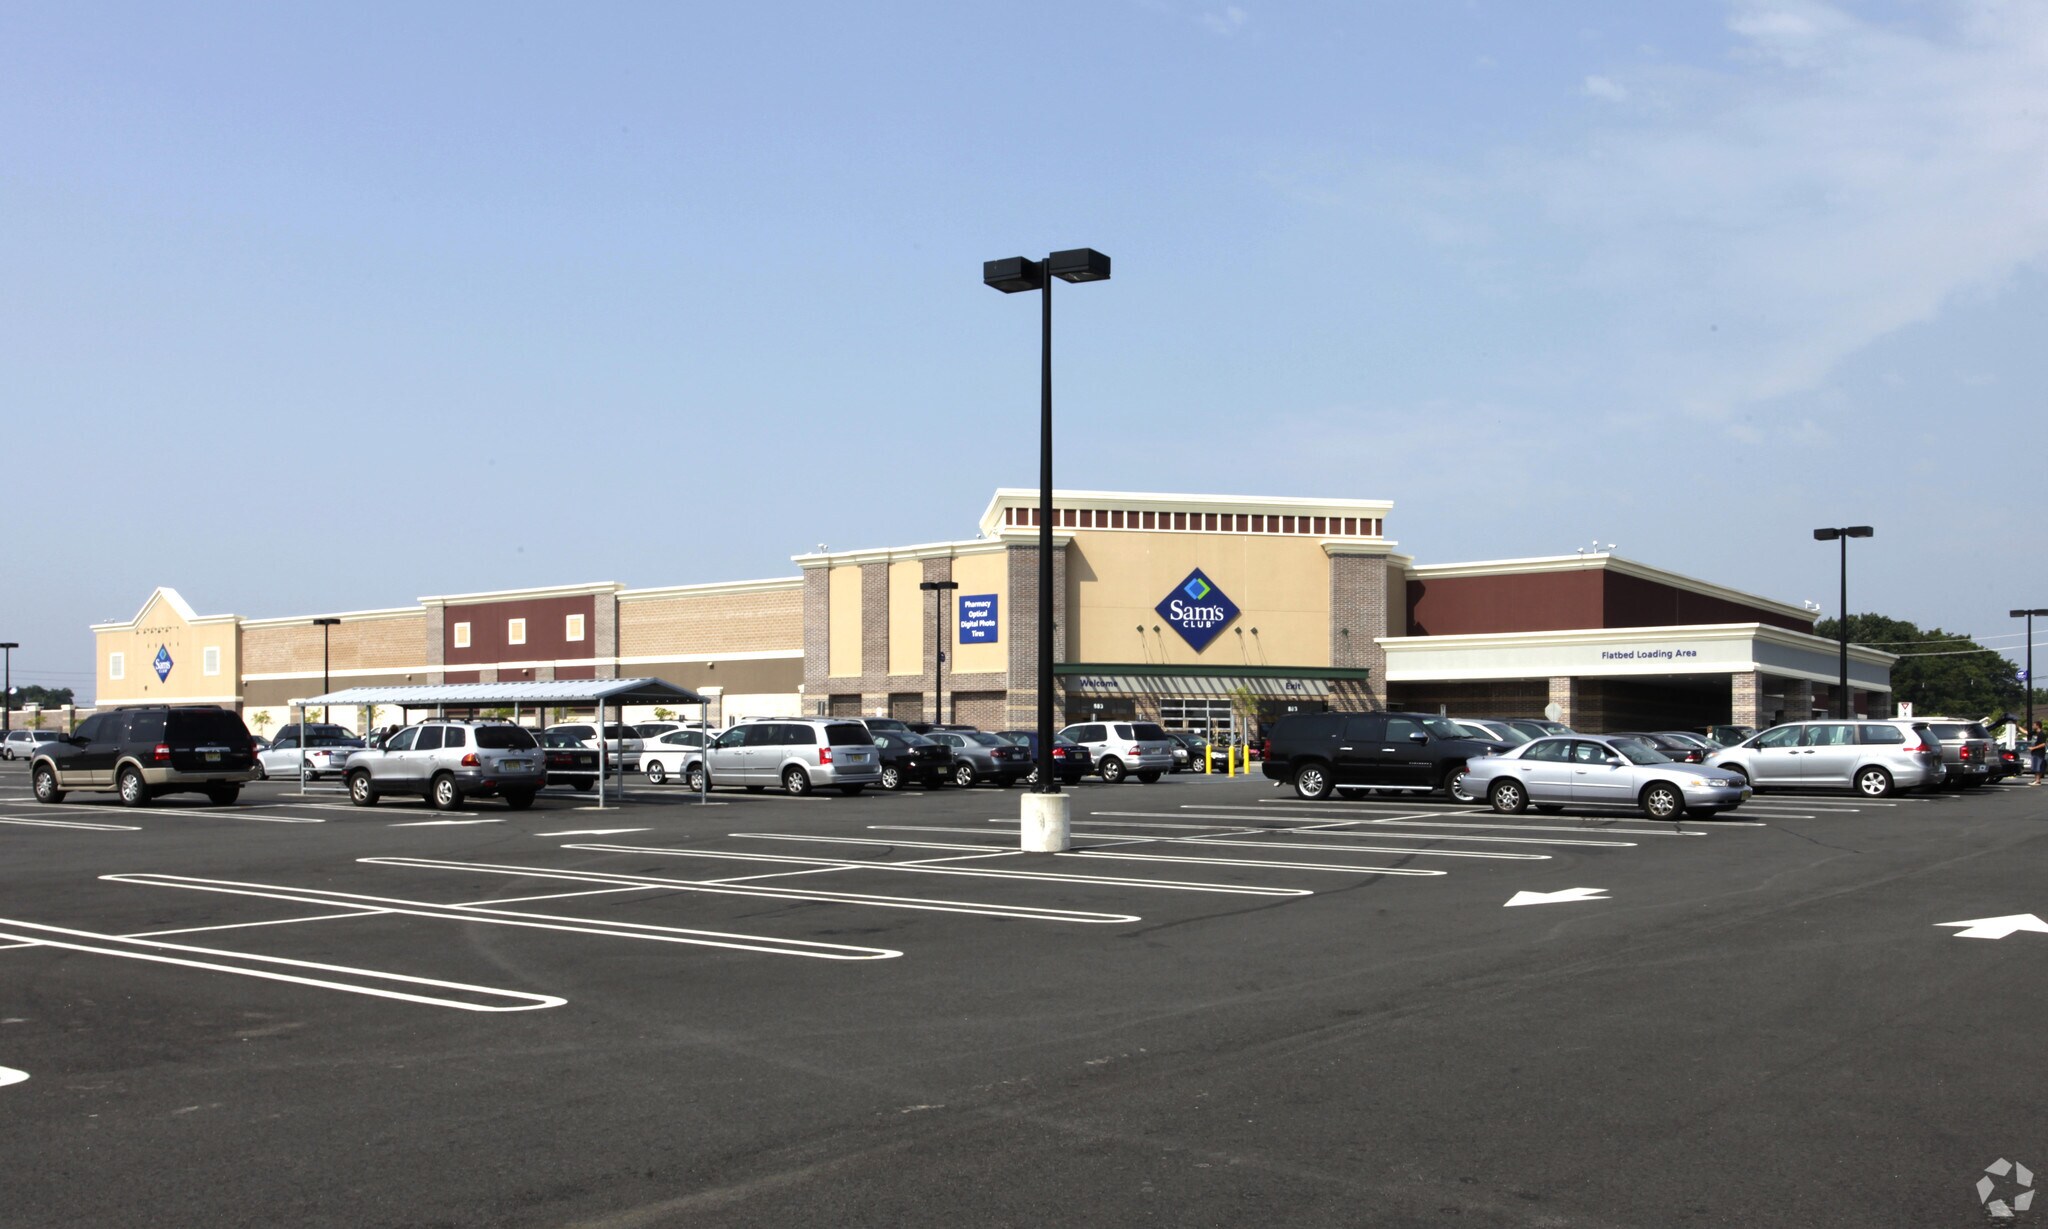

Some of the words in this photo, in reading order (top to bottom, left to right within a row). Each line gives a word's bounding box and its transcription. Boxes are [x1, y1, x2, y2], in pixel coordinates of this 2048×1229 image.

[964, 600, 991, 609] Pharmacy
[968, 610, 988, 619] Optical
[1170, 599, 1224, 621] Sam's
[960, 620, 978, 629] Digital
[1183, 620, 1211, 628] CLUB
[1602, 650, 1634, 659] Flatbed
[1637, 650, 1672, 659] Loading
[1675, 649, 1697, 657] Area
[1080, 679, 1119, 688] Welcome
[1285, 682, 1302, 690] Exit
